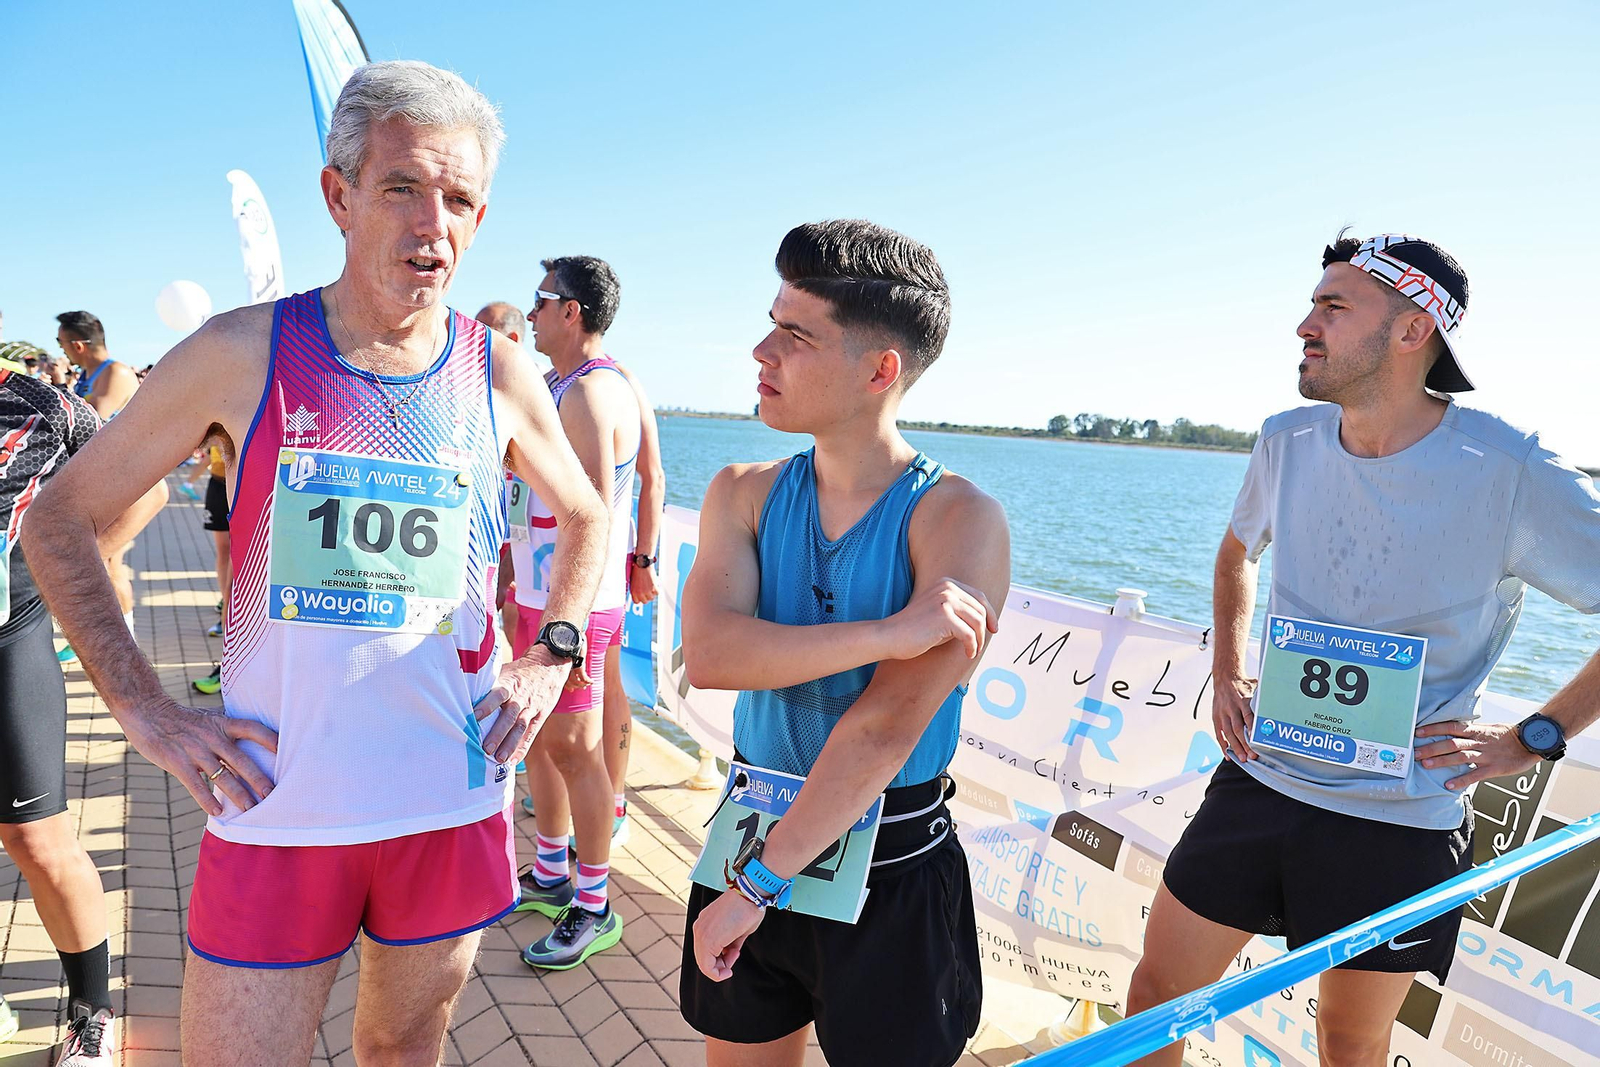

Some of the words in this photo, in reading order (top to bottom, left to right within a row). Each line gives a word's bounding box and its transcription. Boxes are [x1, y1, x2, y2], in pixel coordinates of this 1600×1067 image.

[283, 434, 320, 445] luanvi
[314, 463, 360, 482] HUELVA
[366, 471, 426, 490] AVATEL
[308, 498, 439, 558] 106
[321, 579, 374, 590] HERNANDEZ
[376, 583, 415, 593] HERRERO
[333, 569, 355, 577] JOSE
[358, 571, 406, 581] FRANCISCO
[302, 590, 393, 615] Wayalia
[1293, 628, 1325, 644] HUELVA
[1329, 636, 1379, 654] AVATEL
[1300, 658, 1369, 706] 89
[1304, 719, 1331, 731] FABEIRO
[1332, 725, 1351, 735] CRUZ
[1313, 712, 1343, 724] RICARDO
[1278, 724, 1345, 754] Wayalia
[749, 780, 774, 797] HUELVA
[735, 811, 841, 882] 12
[1069, 822, 1100, 850] Sofás
[1017, 889, 1103, 947] GRATIS
[1041, 954, 1110, 979] HUELVA
